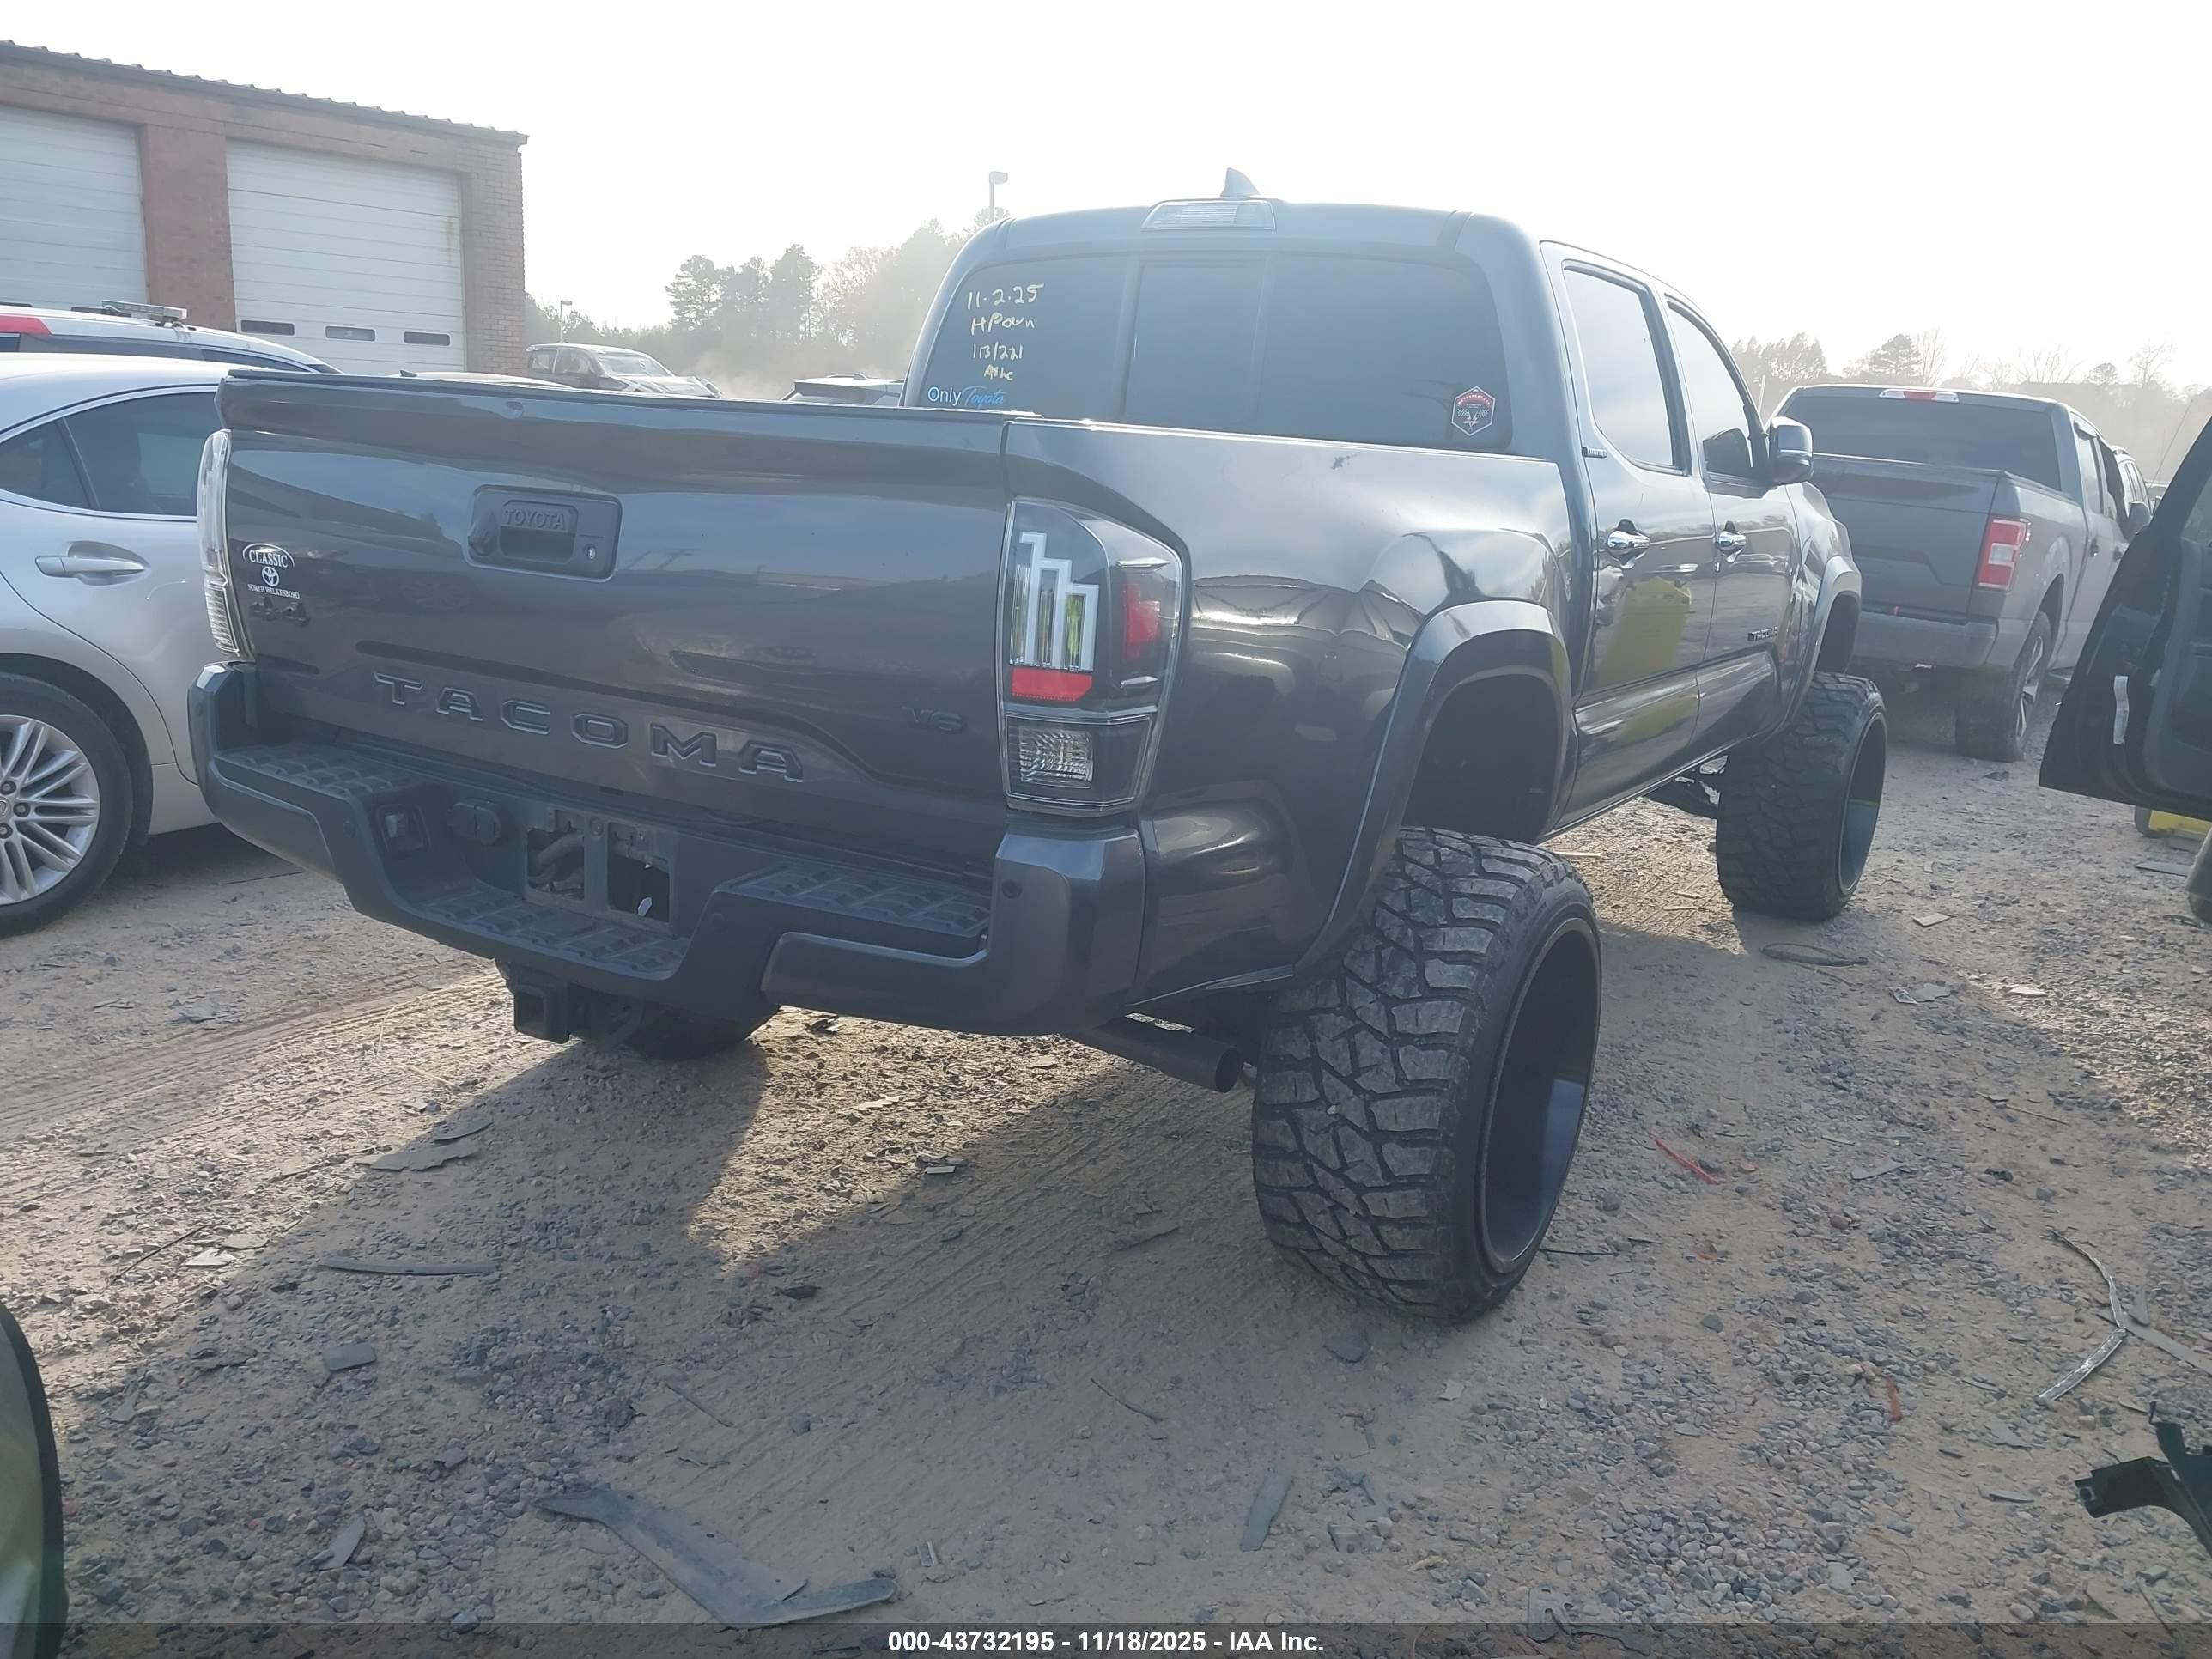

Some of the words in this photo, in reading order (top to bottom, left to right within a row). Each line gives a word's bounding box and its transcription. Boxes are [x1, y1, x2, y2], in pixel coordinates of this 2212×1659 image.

[927, 386, 962, 406] Only
[962, 386, 1010, 410] Toyota
[504, 508, 566, 530] TOYOTA
[249, 549, 289, 568] CLASSIC
[373, 672, 804, 783] TACOMA
